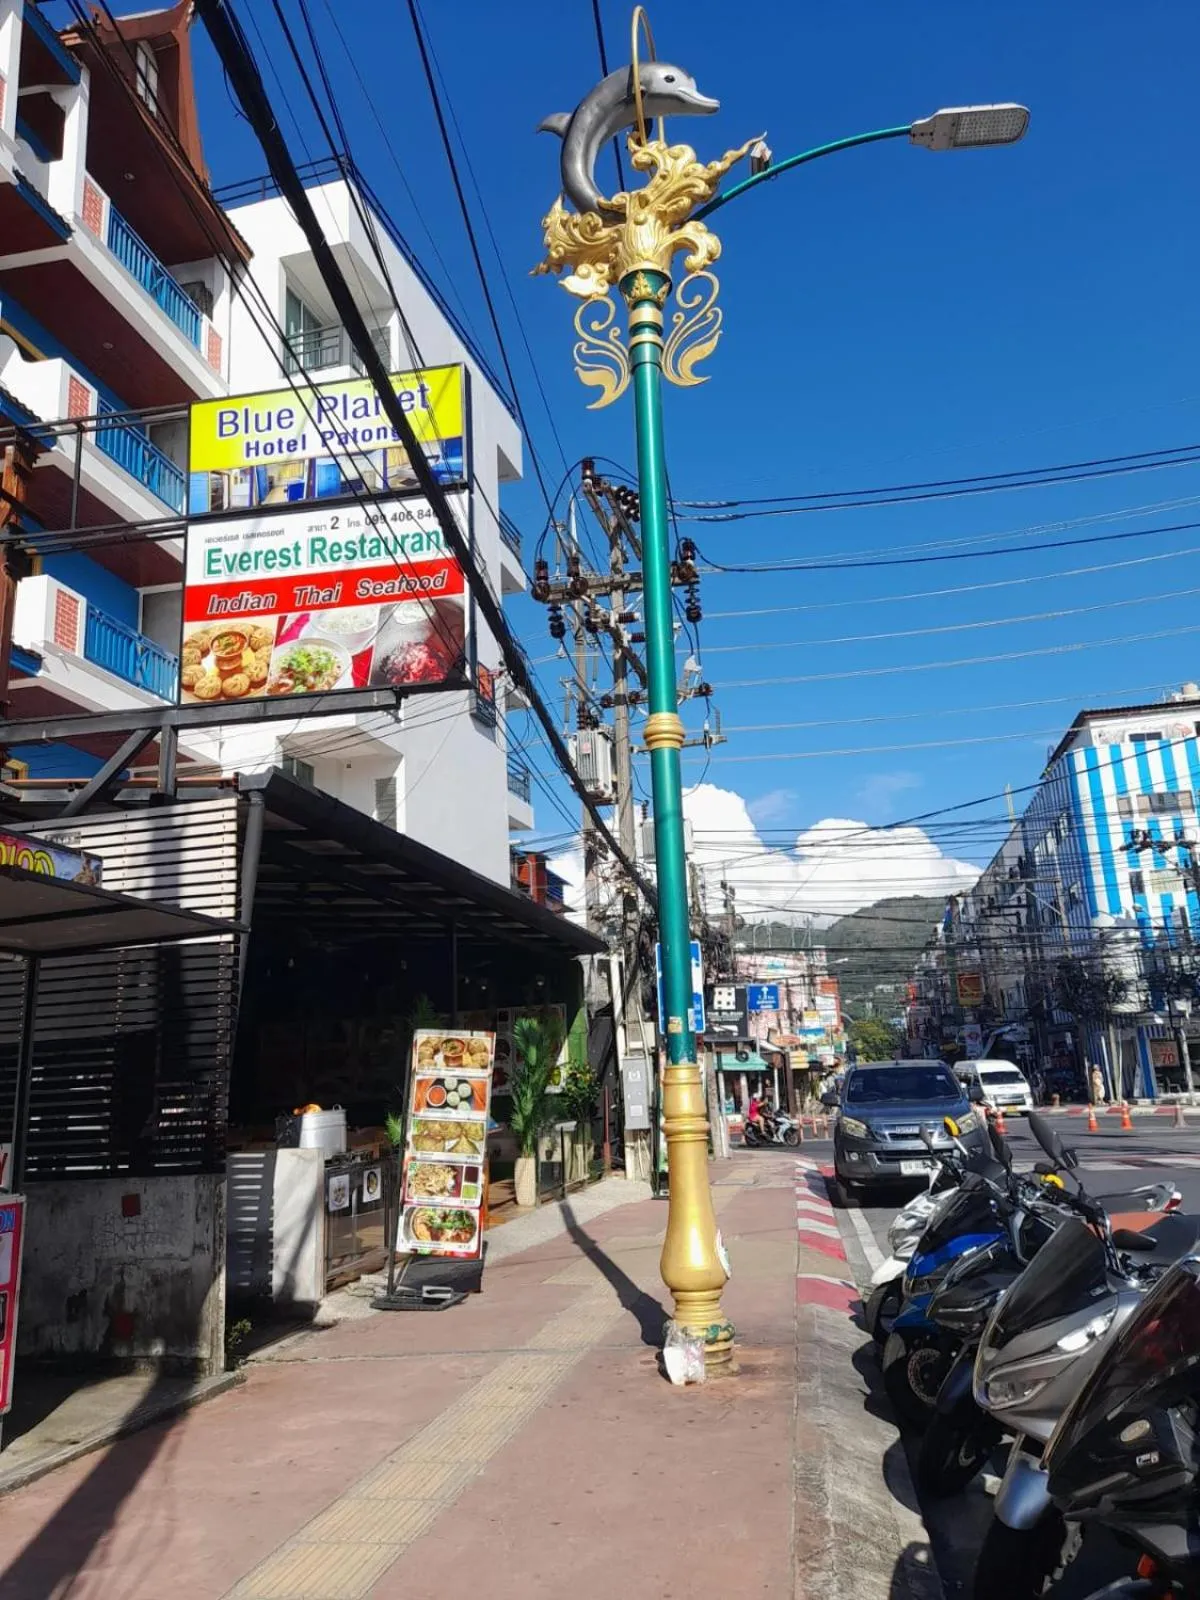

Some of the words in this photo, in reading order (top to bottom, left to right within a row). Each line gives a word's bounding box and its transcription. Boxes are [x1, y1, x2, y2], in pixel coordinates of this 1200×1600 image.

[218, 407, 295, 438] Blue
[245, 433, 307, 459] Hotel
[330, 515, 340, 530] 2
[206, 541, 302, 576] Everest
[310, 529, 450, 565] Restauran
[207, 590, 278, 615] Indian
[294, 576, 343, 608] Thai
[356, 568, 449, 598] Seafood
